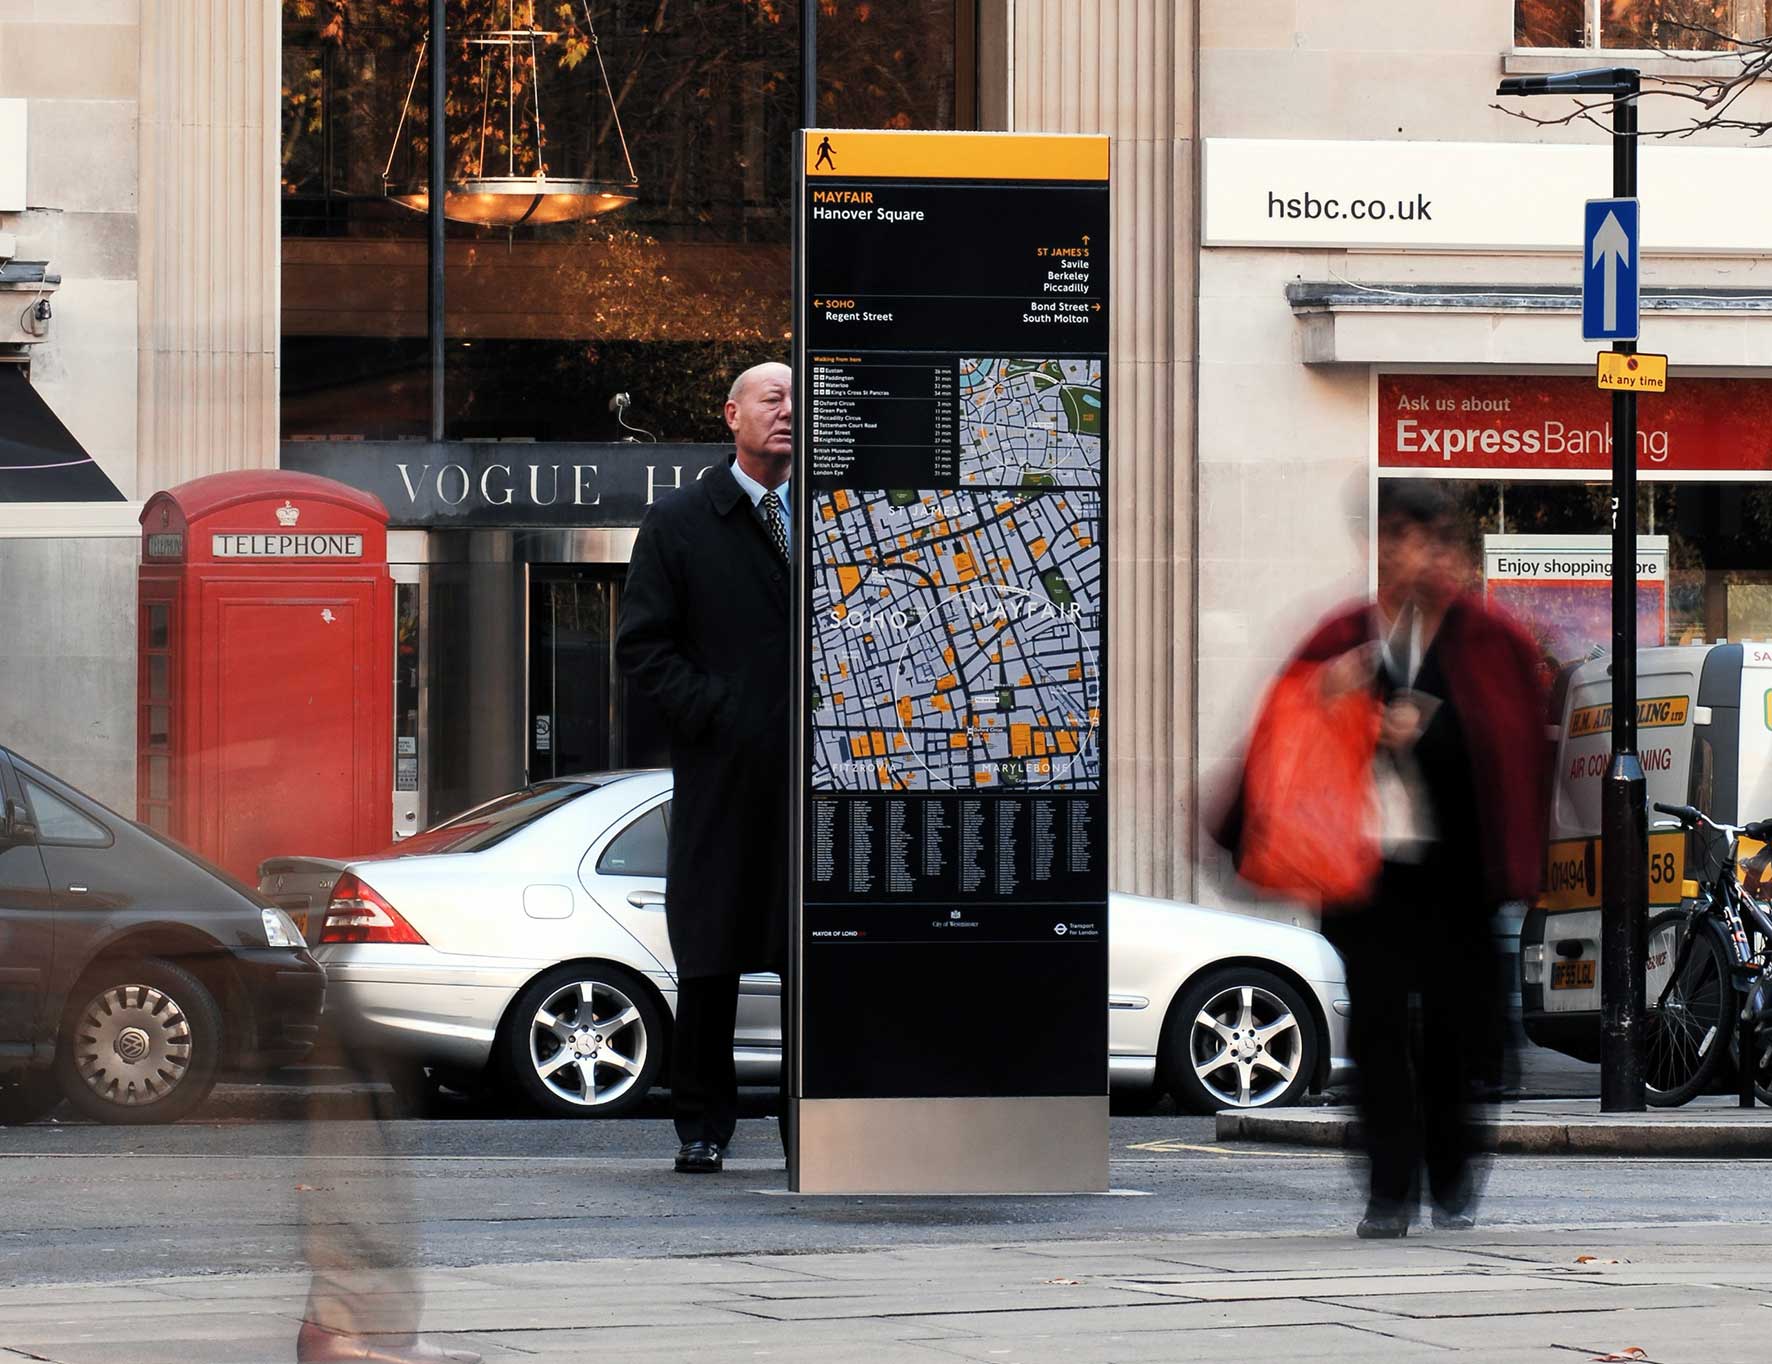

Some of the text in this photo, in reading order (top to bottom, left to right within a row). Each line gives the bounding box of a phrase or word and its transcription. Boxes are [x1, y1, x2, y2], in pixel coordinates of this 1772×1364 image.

[814, 192, 873, 203] MAYFAIR
[1268, 192, 1432, 221] hsbc.co.uk
[814, 208, 924, 223] Hanover Square
[1037, 248, 1048, 256] ST
[1061, 259, 1089, 269] Savile
[1048, 272, 1089, 282] Berkeley
[1044, 283, 1089, 294] Piccadilly
[826, 300, 855, 309] SOHO
[1031, 302, 1089, 312] Bond Street
[826, 312, 893, 322] Regent Street
[1023, 314, 1089, 324] South Molton
[1601, 374, 1663, 387] At any time
[1398, 396, 1511, 412] Ask us about
[1397, 420, 1669, 463] ExpressBankng
[396, 464, 601, 505] VOGUE
[217, 535, 357, 556] TELEPHONE
[1497, 558, 1657, 577] Enjoy shopping ore
[970, 601, 1082, 619] MAYFAIR
[830, 610, 907, 629] SOHO
[982, 763, 1070, 773] MARYLEBONE
[1570, 756, 1585, 779] AIR
